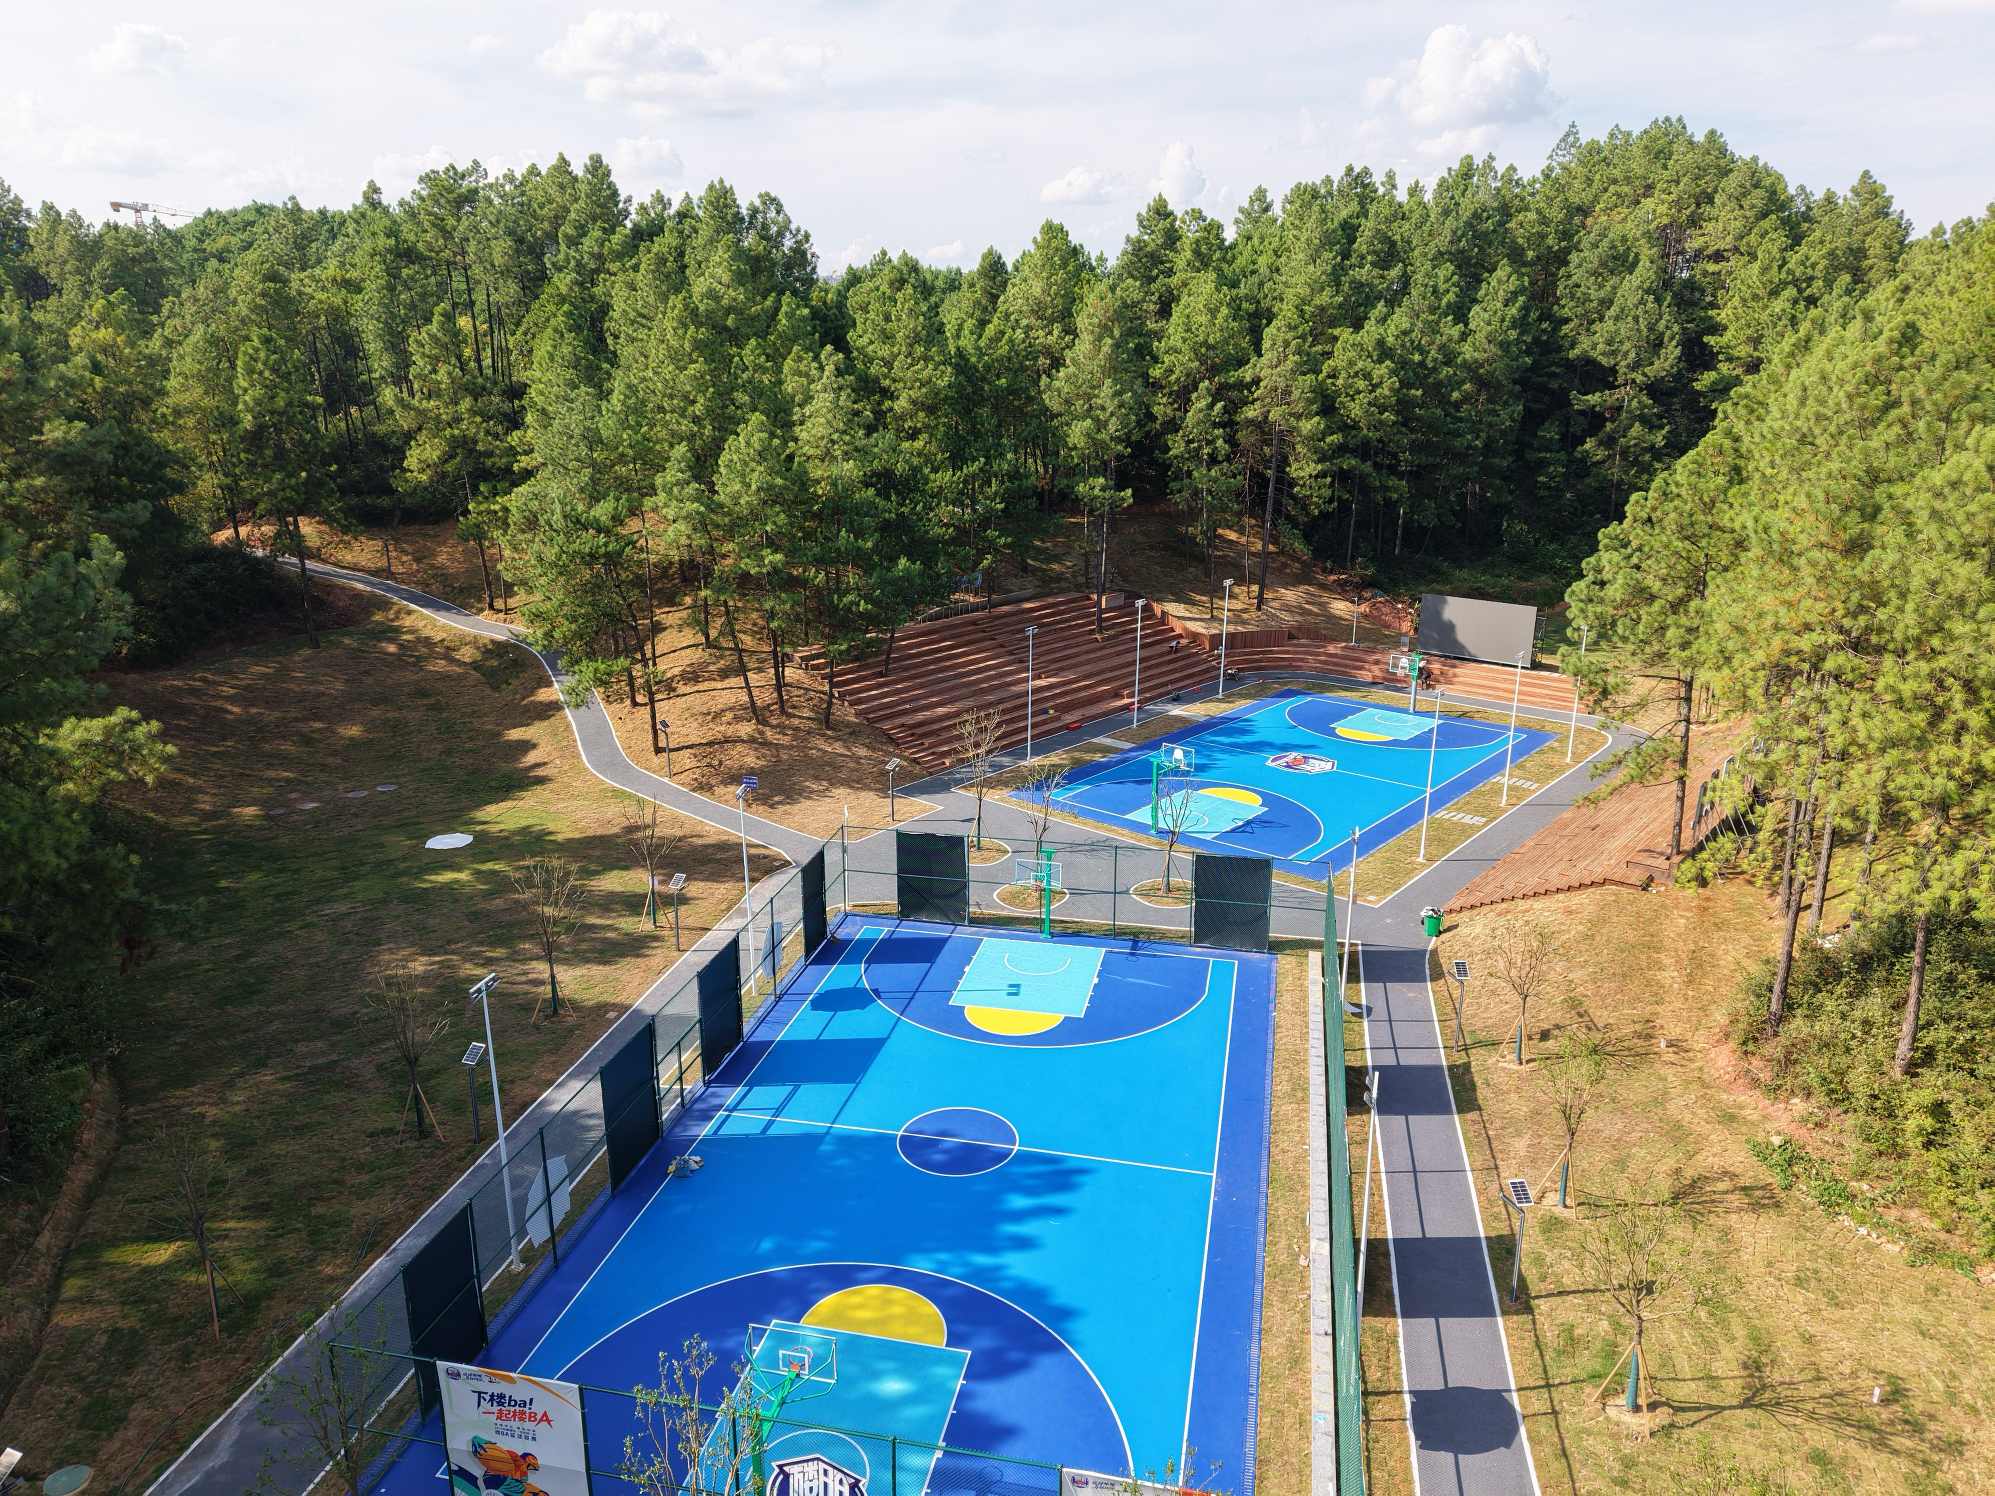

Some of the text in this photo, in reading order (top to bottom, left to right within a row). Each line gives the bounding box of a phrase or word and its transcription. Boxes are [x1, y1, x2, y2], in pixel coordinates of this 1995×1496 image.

[471, 1389, 534, 1411] 下楼ba!
[481, 1407, 554, 1429] 一起楼BA
